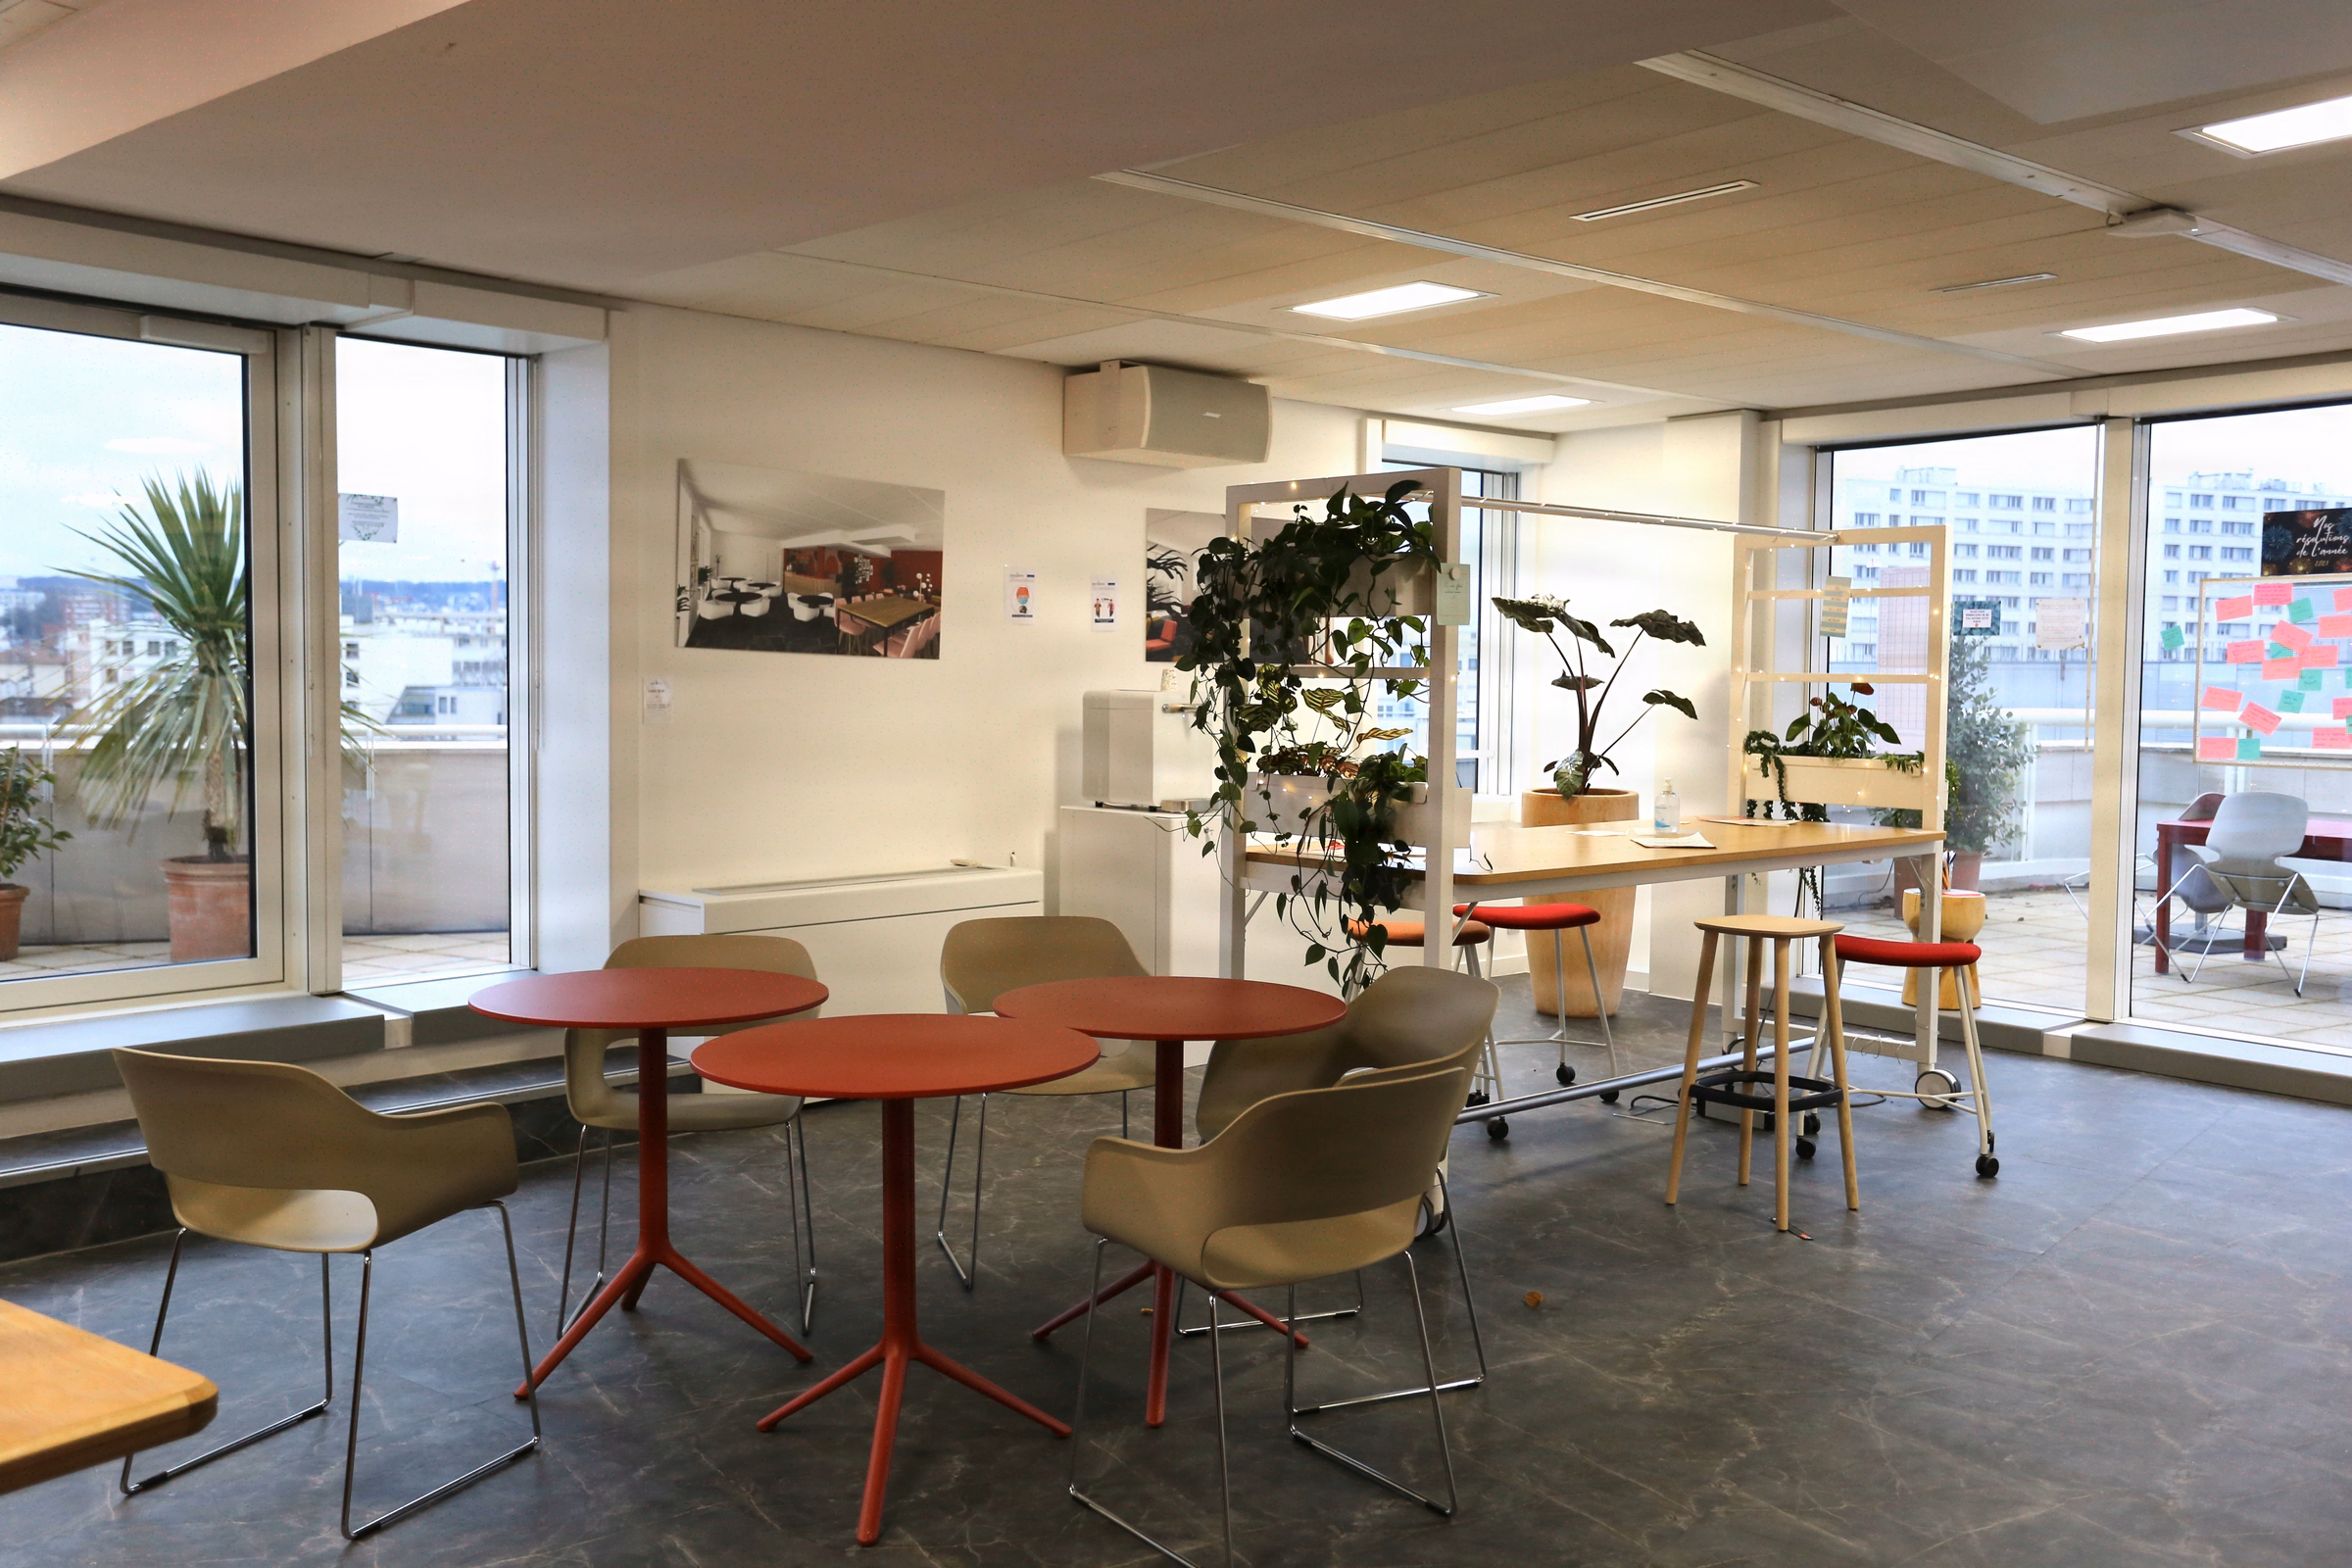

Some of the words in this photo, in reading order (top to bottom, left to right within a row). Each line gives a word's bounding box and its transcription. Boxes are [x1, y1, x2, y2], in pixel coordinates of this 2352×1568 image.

[2313, 514, 2335, 530] Nos
[2295, 530, 2350, 546] résolutions
[2296, 542, 2308, 558] de
